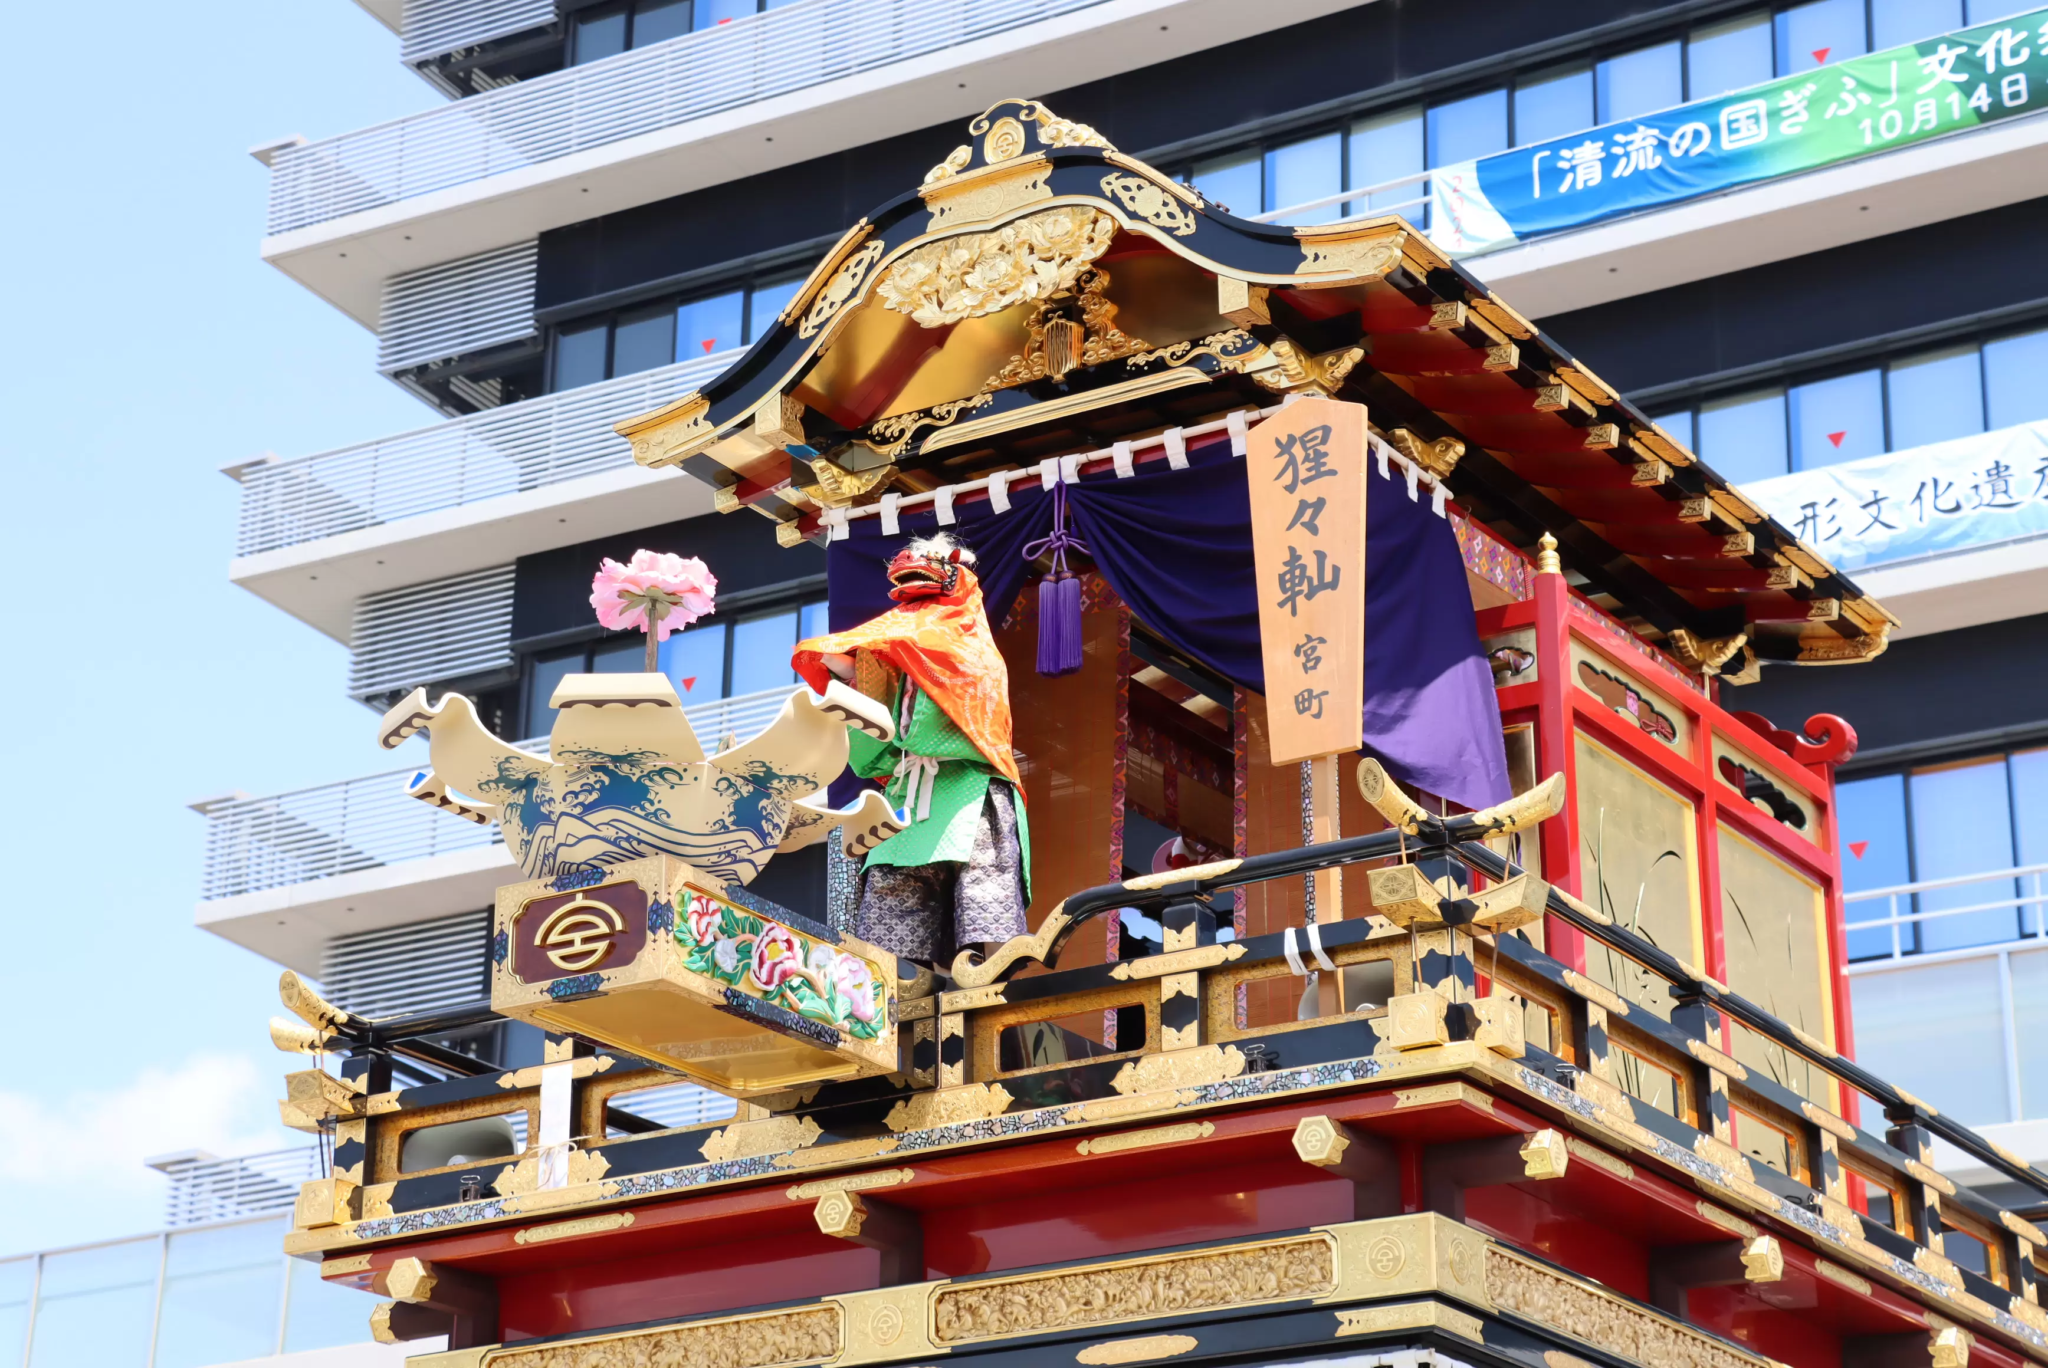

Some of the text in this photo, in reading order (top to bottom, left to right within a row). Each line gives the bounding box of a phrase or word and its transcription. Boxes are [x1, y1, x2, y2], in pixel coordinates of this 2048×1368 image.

[1532, 22, 2048, 198] 「清流の国ぎふ」文化
[1858, 72, 2029, 145] 10月14日
